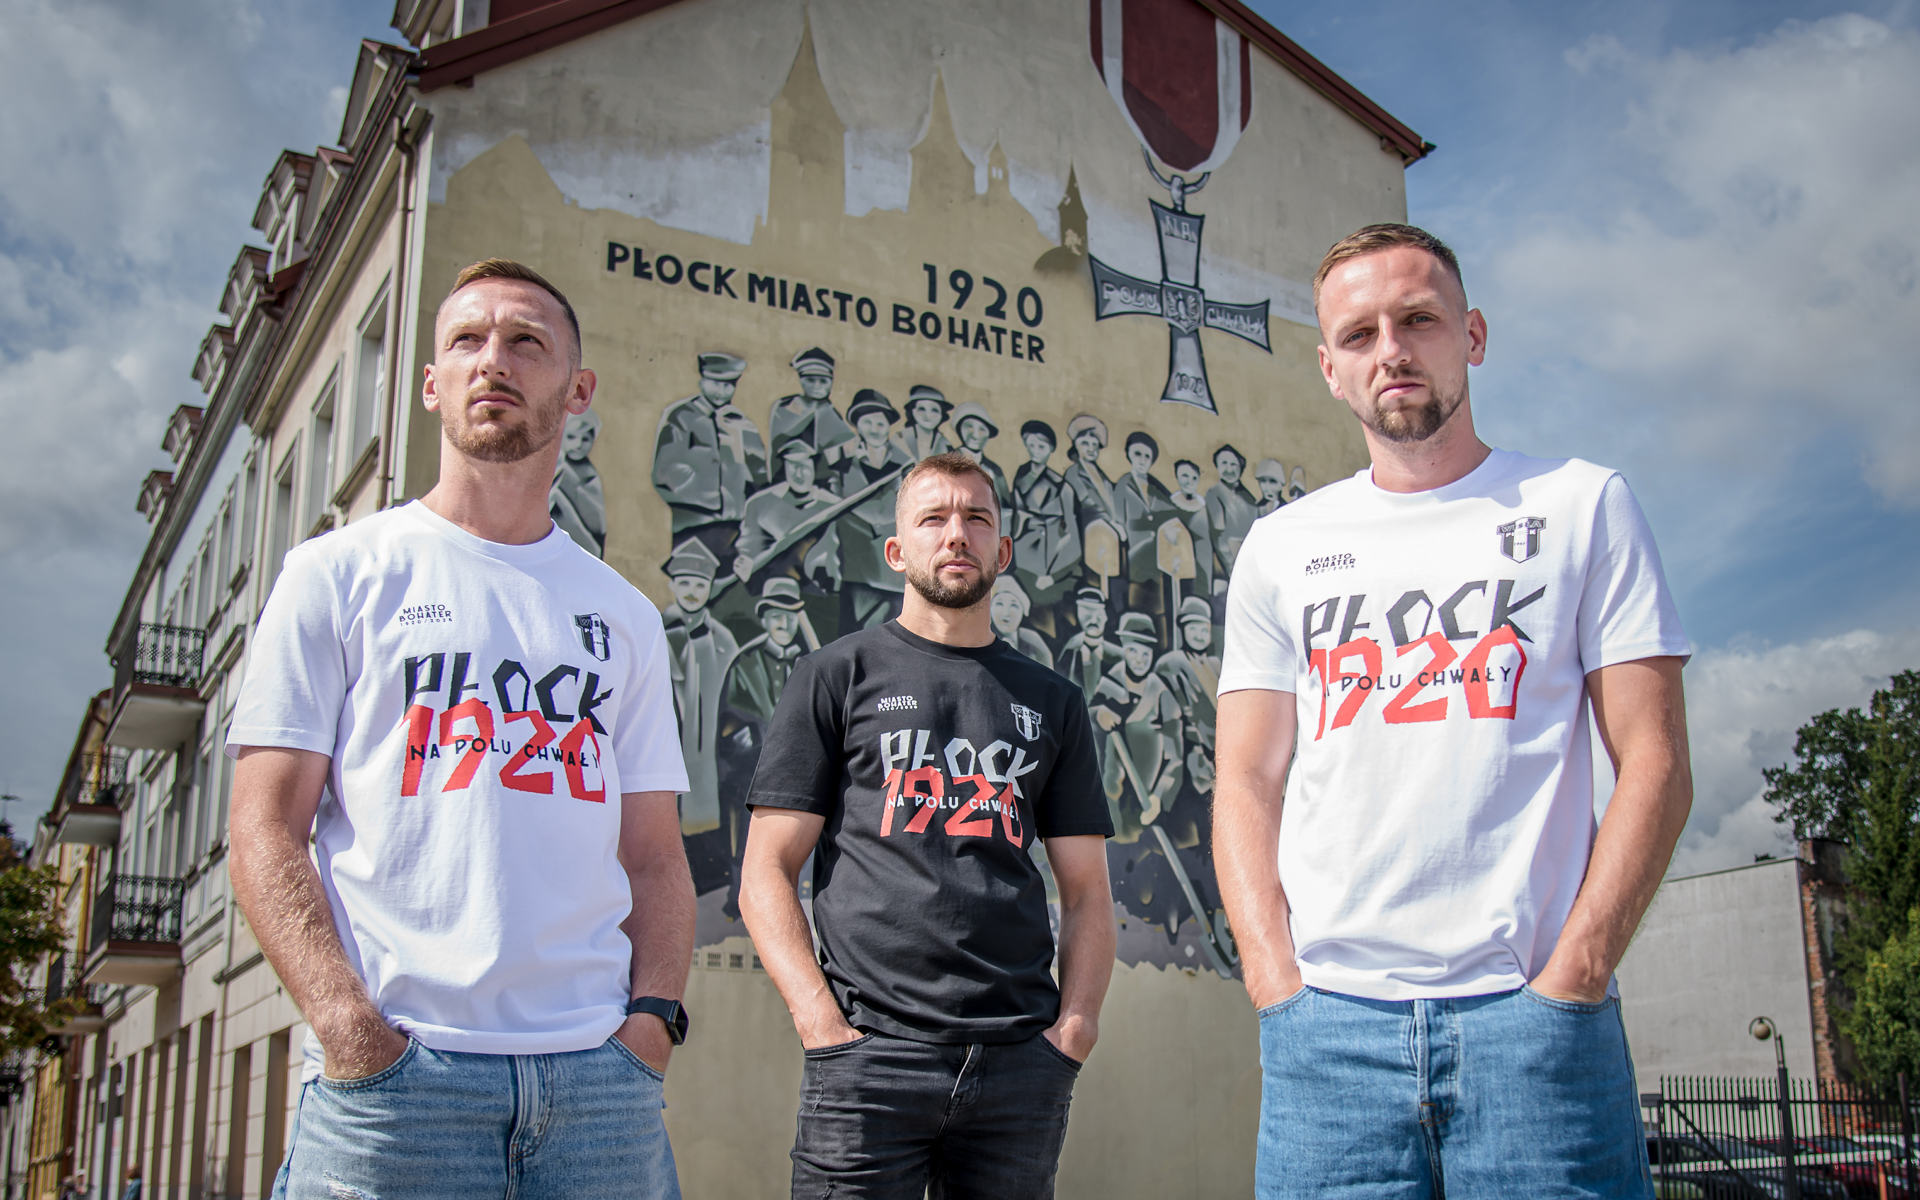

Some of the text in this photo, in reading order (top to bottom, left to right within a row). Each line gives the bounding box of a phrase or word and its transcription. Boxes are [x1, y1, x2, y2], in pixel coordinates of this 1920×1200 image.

[1163, 216, 1196, 243] NA
[606, 241, 1045, 363] PŁOCK MIASTO BOHATER
[923, 263, 1044, 328] 1920
[1102, 281, 1158, 310] POLU
[1305, 558, 1356, 572] BOHATER
[1311, 552, 1352, 565] MIASTO
[399, 610, 452, 622] BOHATER
[403, 604, 446, 615] MIASTO
[1303, 579, 1547, 667] PŁOCK
[1308, 624, 1528, 741] 1920
[1341, 673, 1401, 691] POLU
[1417, 666, 1511, 687] CHWAŁY
[404, 652, 614, 736] PŁOCK
[877, 699, 918, 709] BOHATER
[880, 695, 914, 705] MIASTO
[398, 697, 606, 804] 1920
[410, 744, 441, 761] NA
[455, 737, 511, 754] POLU
[880, 729, 1039, 800] PŁOCK
[880, 765, 1024, 849] 1920
[887, 794, 905, 810] NA
[915, 794, 959, 809] POLU
